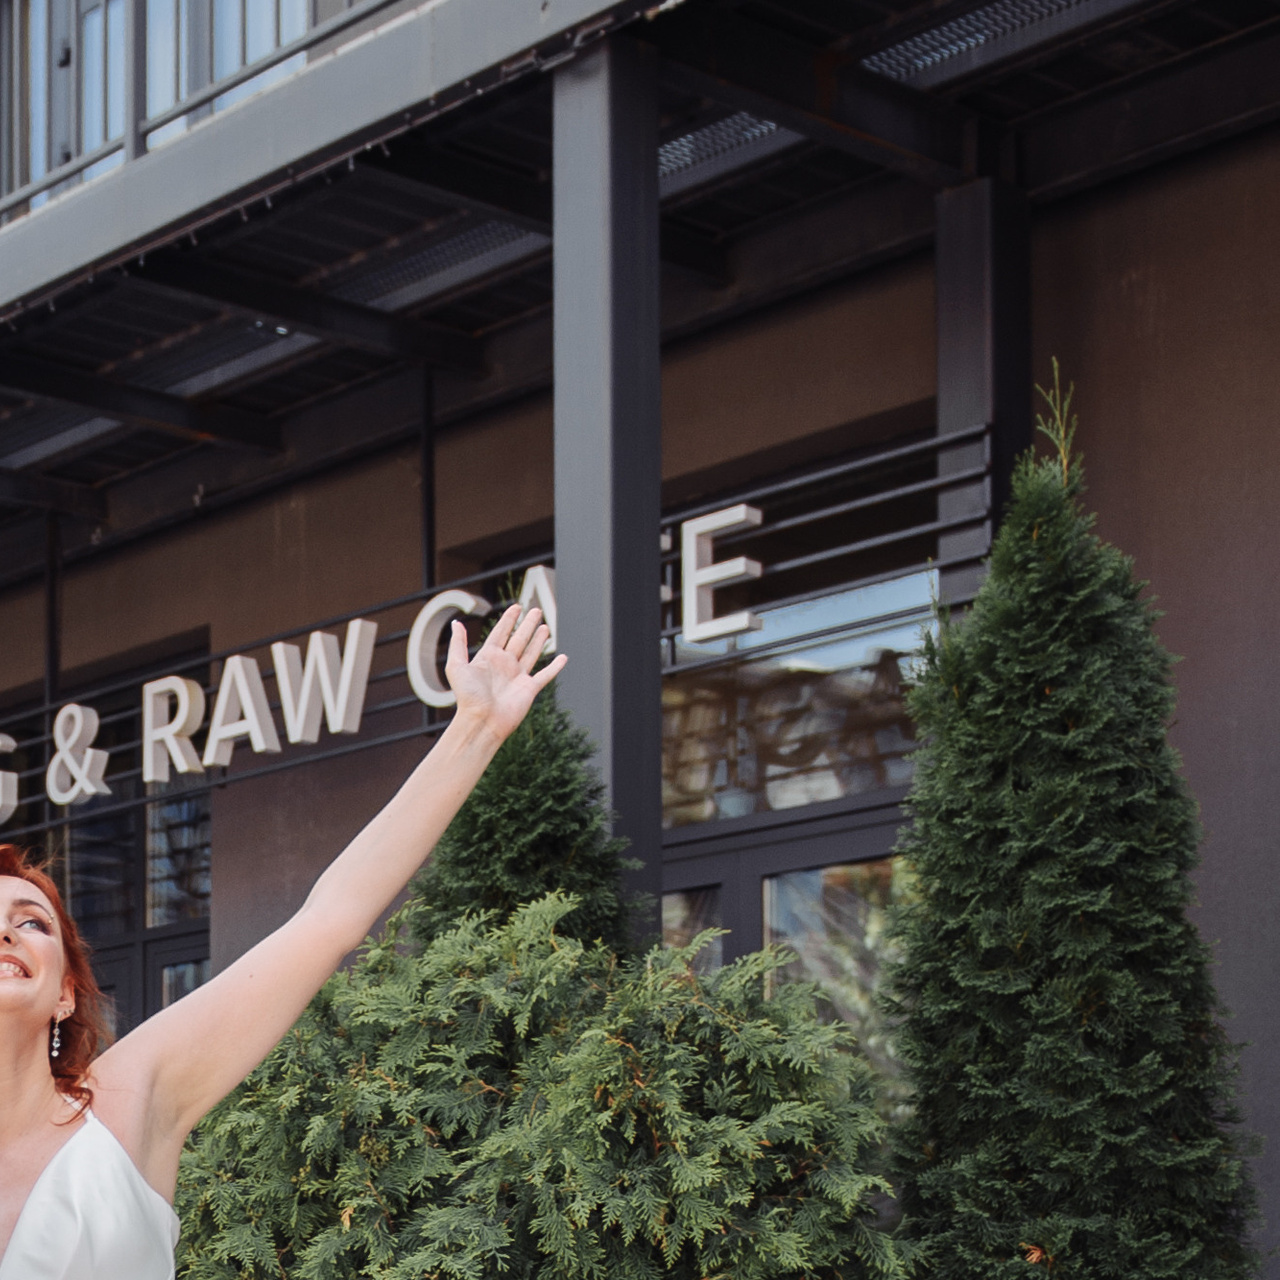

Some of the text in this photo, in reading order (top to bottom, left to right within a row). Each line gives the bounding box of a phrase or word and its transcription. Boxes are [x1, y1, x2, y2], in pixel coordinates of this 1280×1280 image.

[46, 703, 112, 805] &
[142, 618, 378, 783] RAW
[407, 503, 763, 708] CAE
